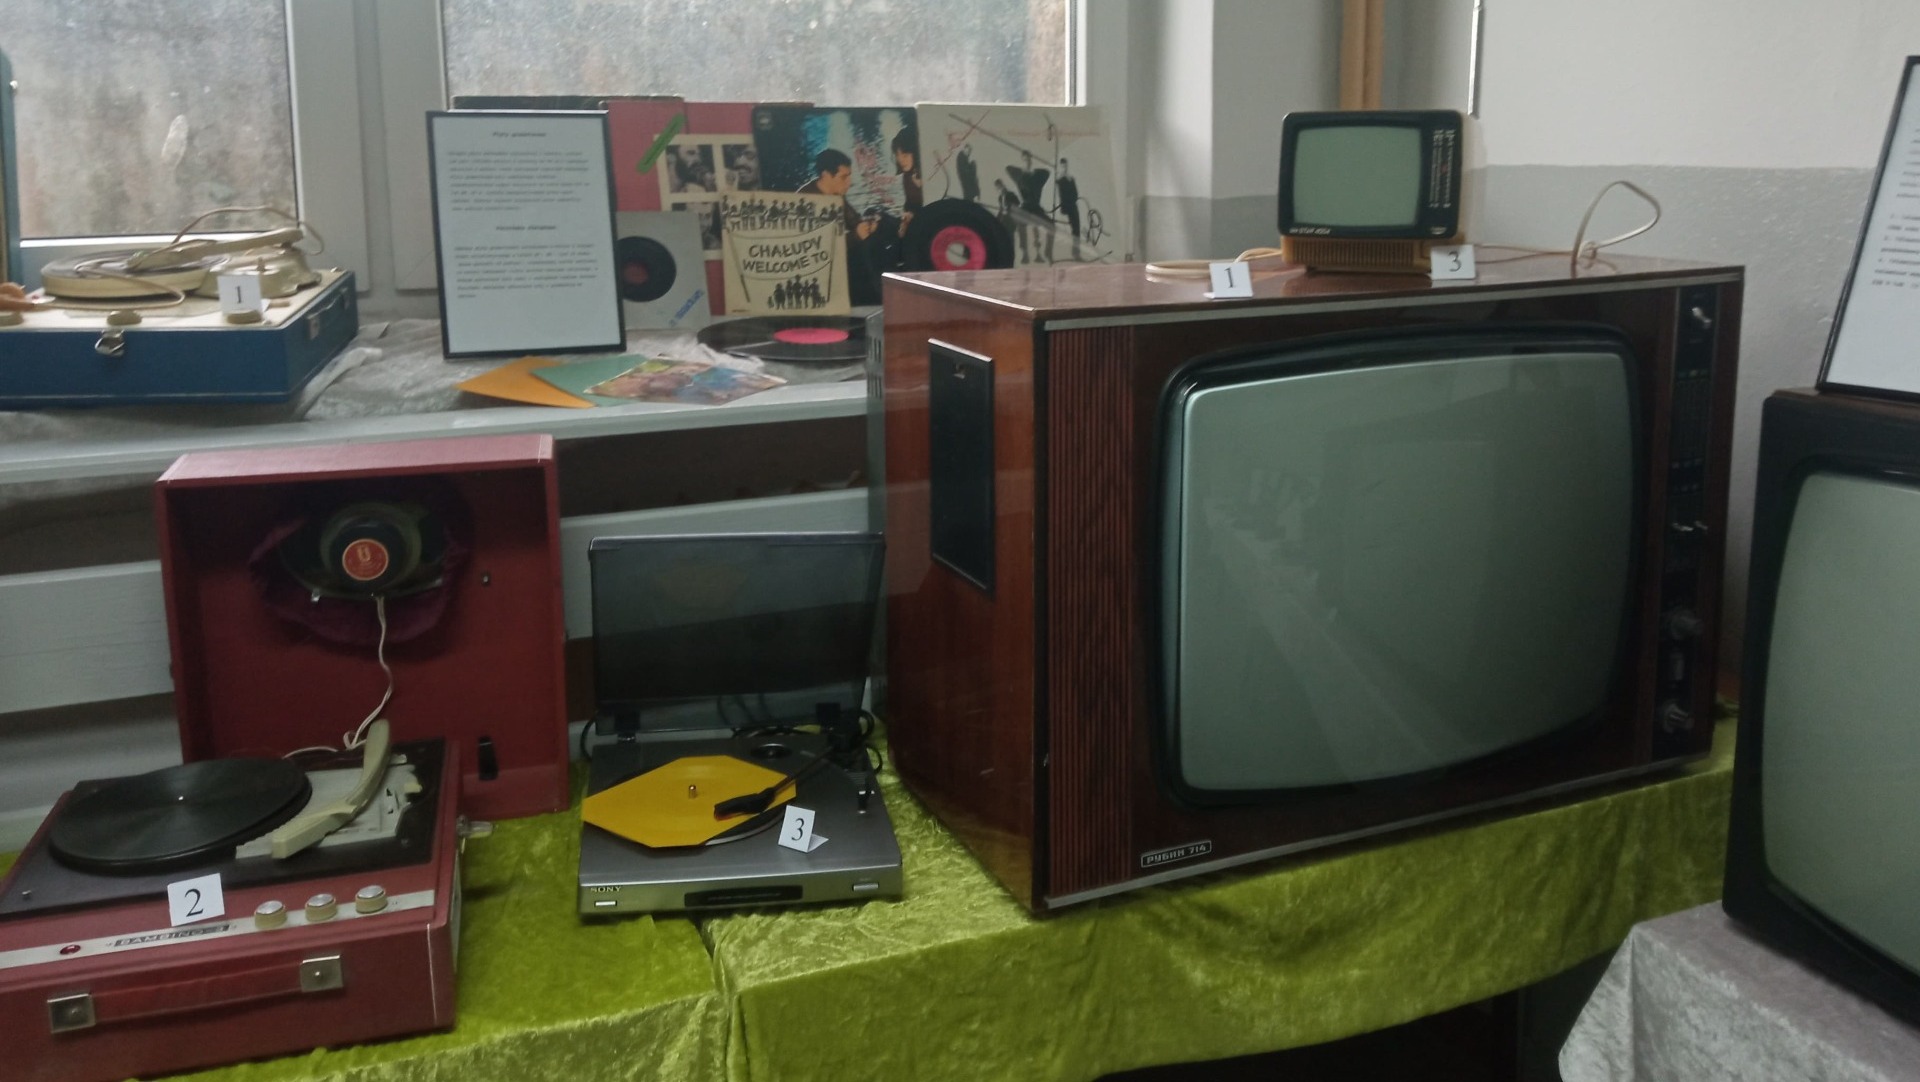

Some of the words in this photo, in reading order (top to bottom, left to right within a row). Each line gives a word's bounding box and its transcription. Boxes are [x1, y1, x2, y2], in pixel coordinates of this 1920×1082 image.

[748, 235, 822, 259] CHAŁUPY
[742, 255, 810, 274] WELCOME
[810, 250, 829, 264] TO
[1448, 251, 1462, 272] 3
[1223, 267, 1236, 289] 1
[236, 286, 243, 303] 1
[791, 817, 805, 841] 3
[185, 888, 204, 918] 2
